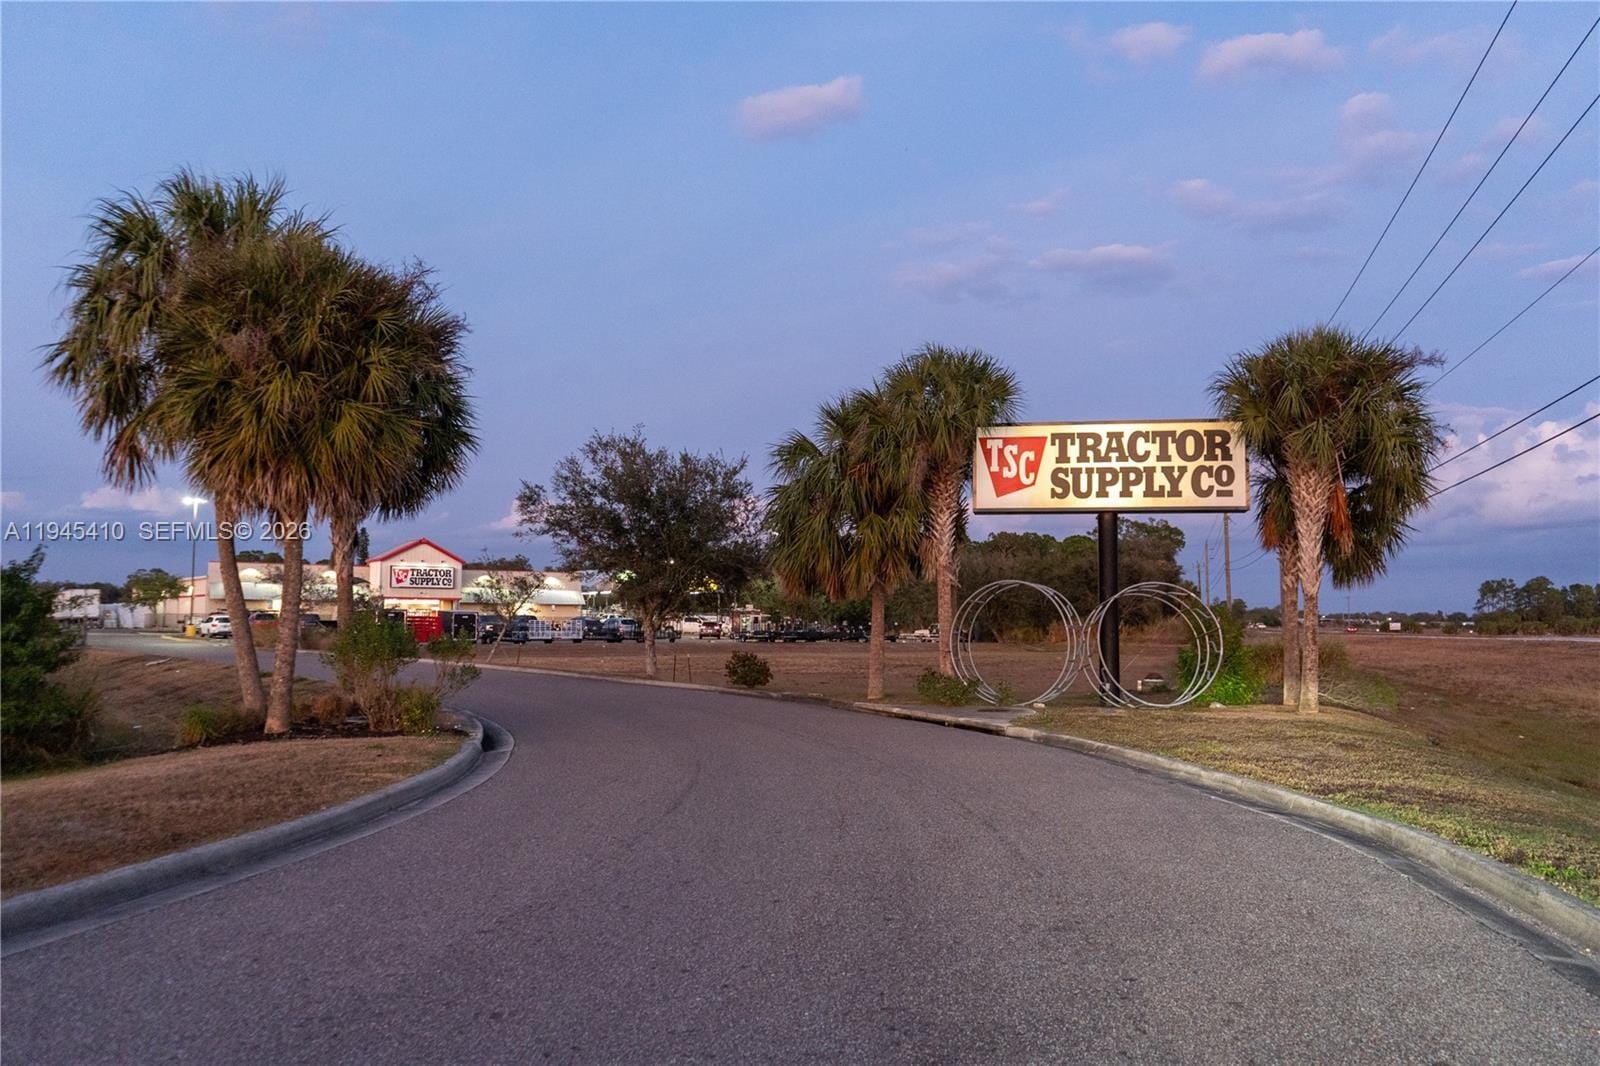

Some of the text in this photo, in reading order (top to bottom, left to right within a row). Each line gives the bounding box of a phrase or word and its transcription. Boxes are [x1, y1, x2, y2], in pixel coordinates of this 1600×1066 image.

[986, 439, 1036, 485] TSC
[1051, 430, 1233, 463] TRACTOR
[1050, 465, 1188, 499] SUPPLY
[409, 577, 441, 586] SUPPLY
[410, 569, 452, 577] TRACTOR
